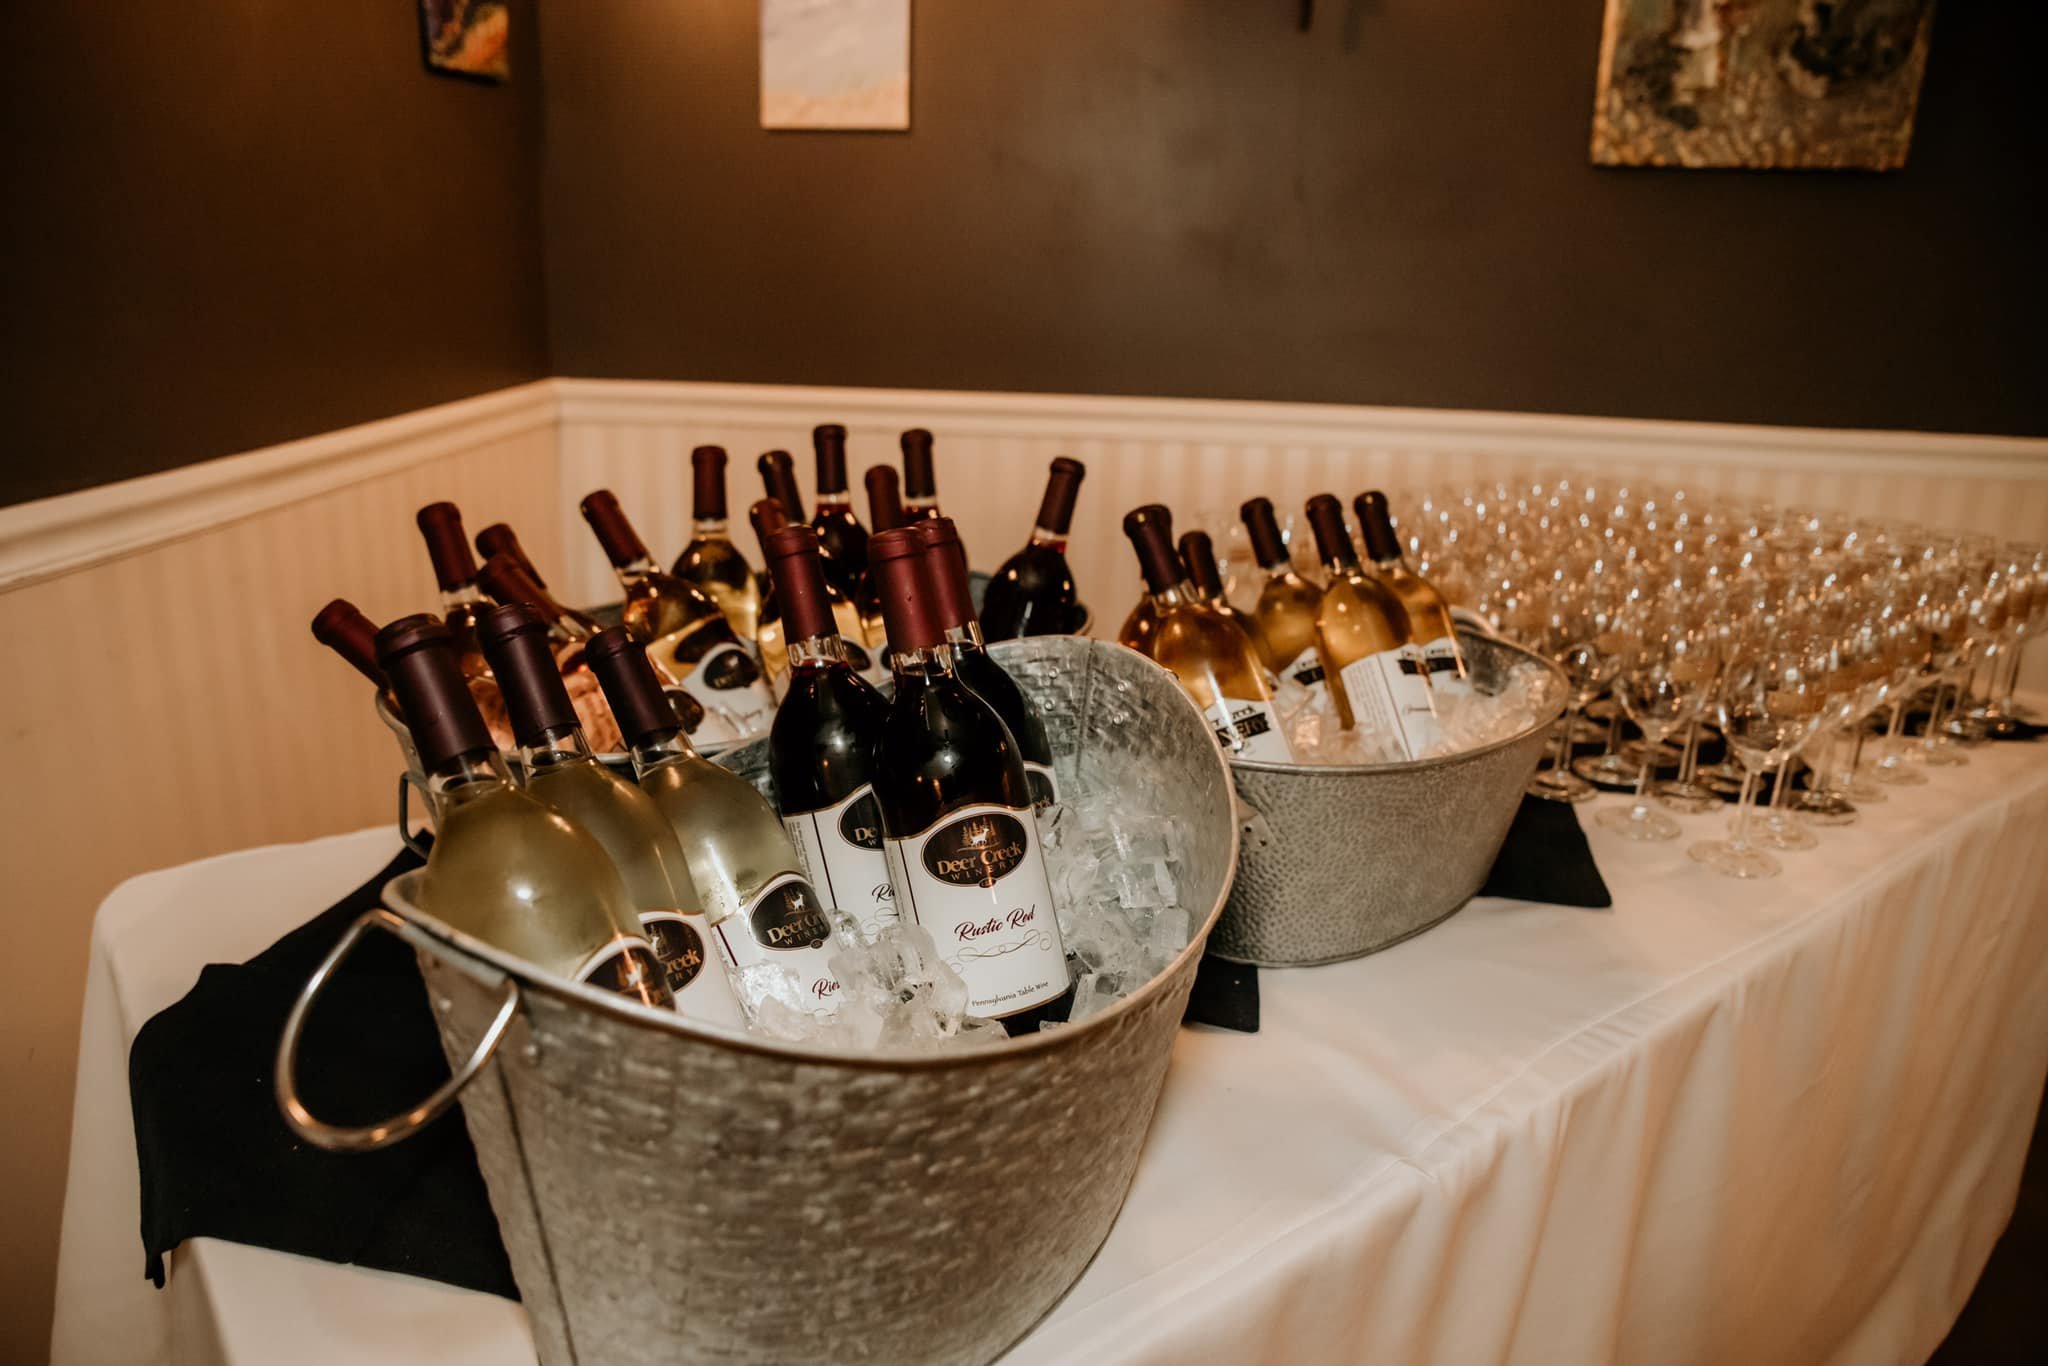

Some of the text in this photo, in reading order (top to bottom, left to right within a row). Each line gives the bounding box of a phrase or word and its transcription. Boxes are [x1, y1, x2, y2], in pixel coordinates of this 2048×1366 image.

[937, 841, 1022, 876] Deer Creek
[951, 859, 1016, 881] WINERY
[767, 920, 804, 944] Deer
[954, 904, 1036, 942] Rustic Red
[666, 949, 702, 975] reek
[971, 981, 1049, 1007] Pennsylvania Table Wine
